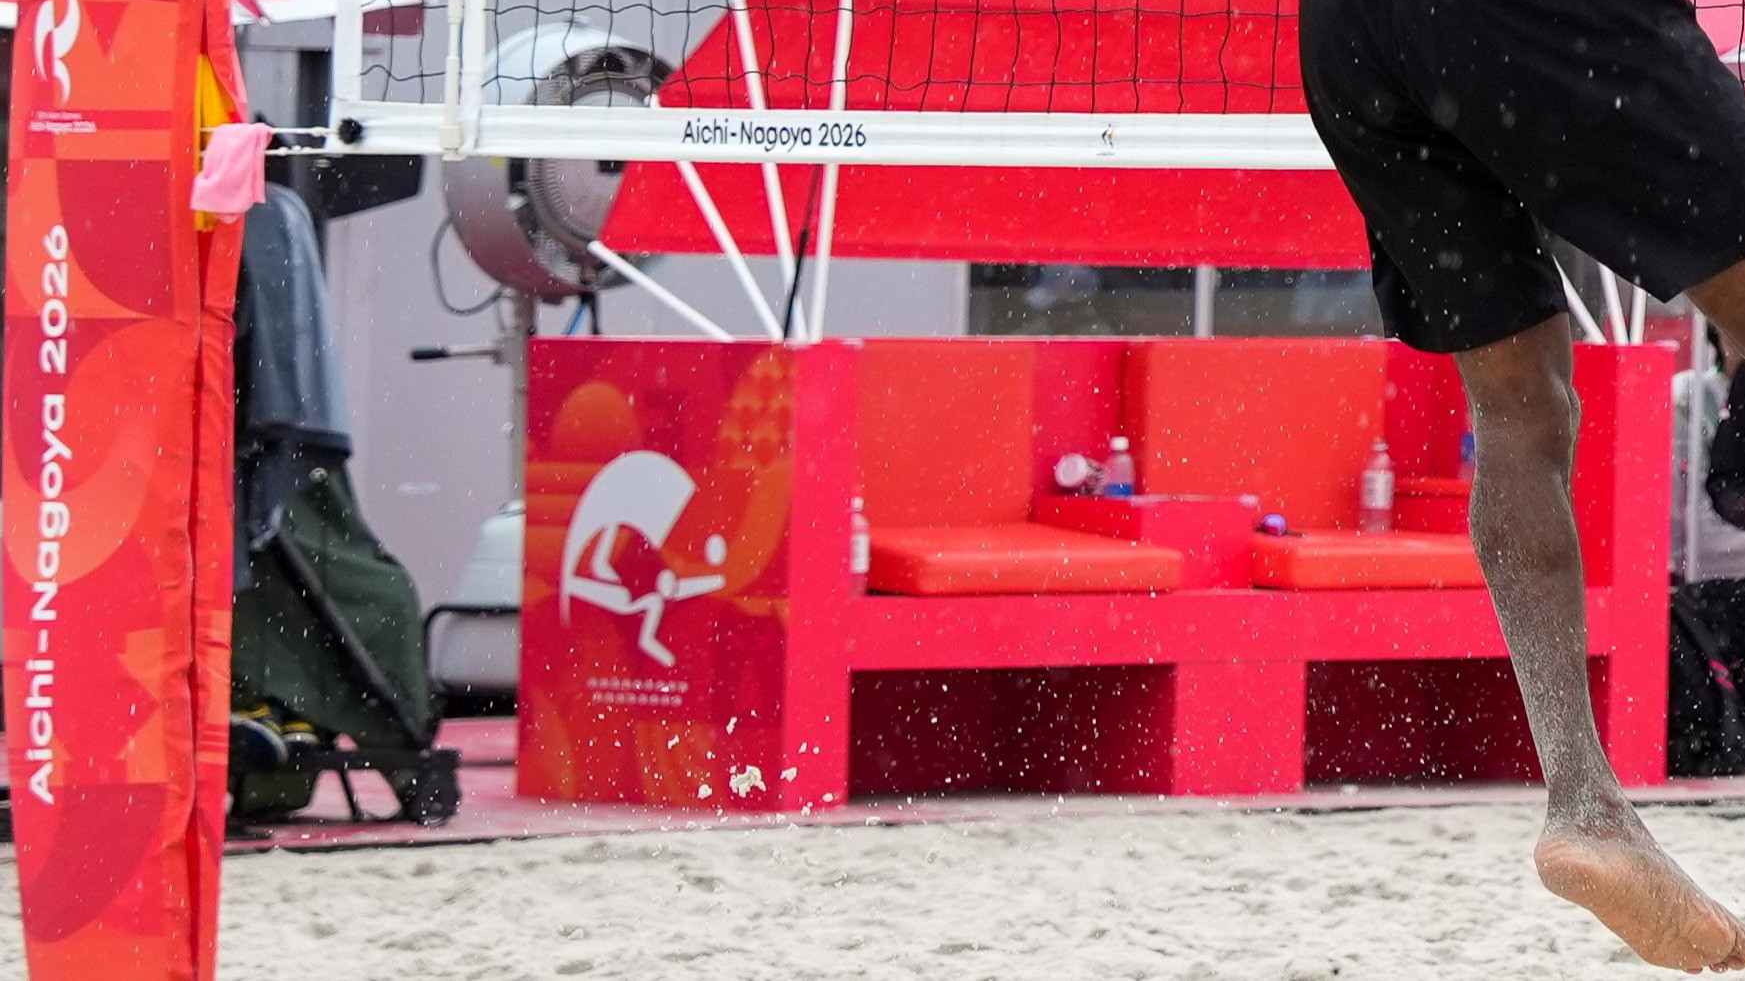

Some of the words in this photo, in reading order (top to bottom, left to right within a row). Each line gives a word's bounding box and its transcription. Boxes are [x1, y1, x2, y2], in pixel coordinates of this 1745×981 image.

[682, 118, 812, 152] Aichi-Nagoya
[818, 122, 867, 147] 2026
[41, 224, 69, 374] 2026
[26, 394, 73, 805] Aichi-Nagoya
